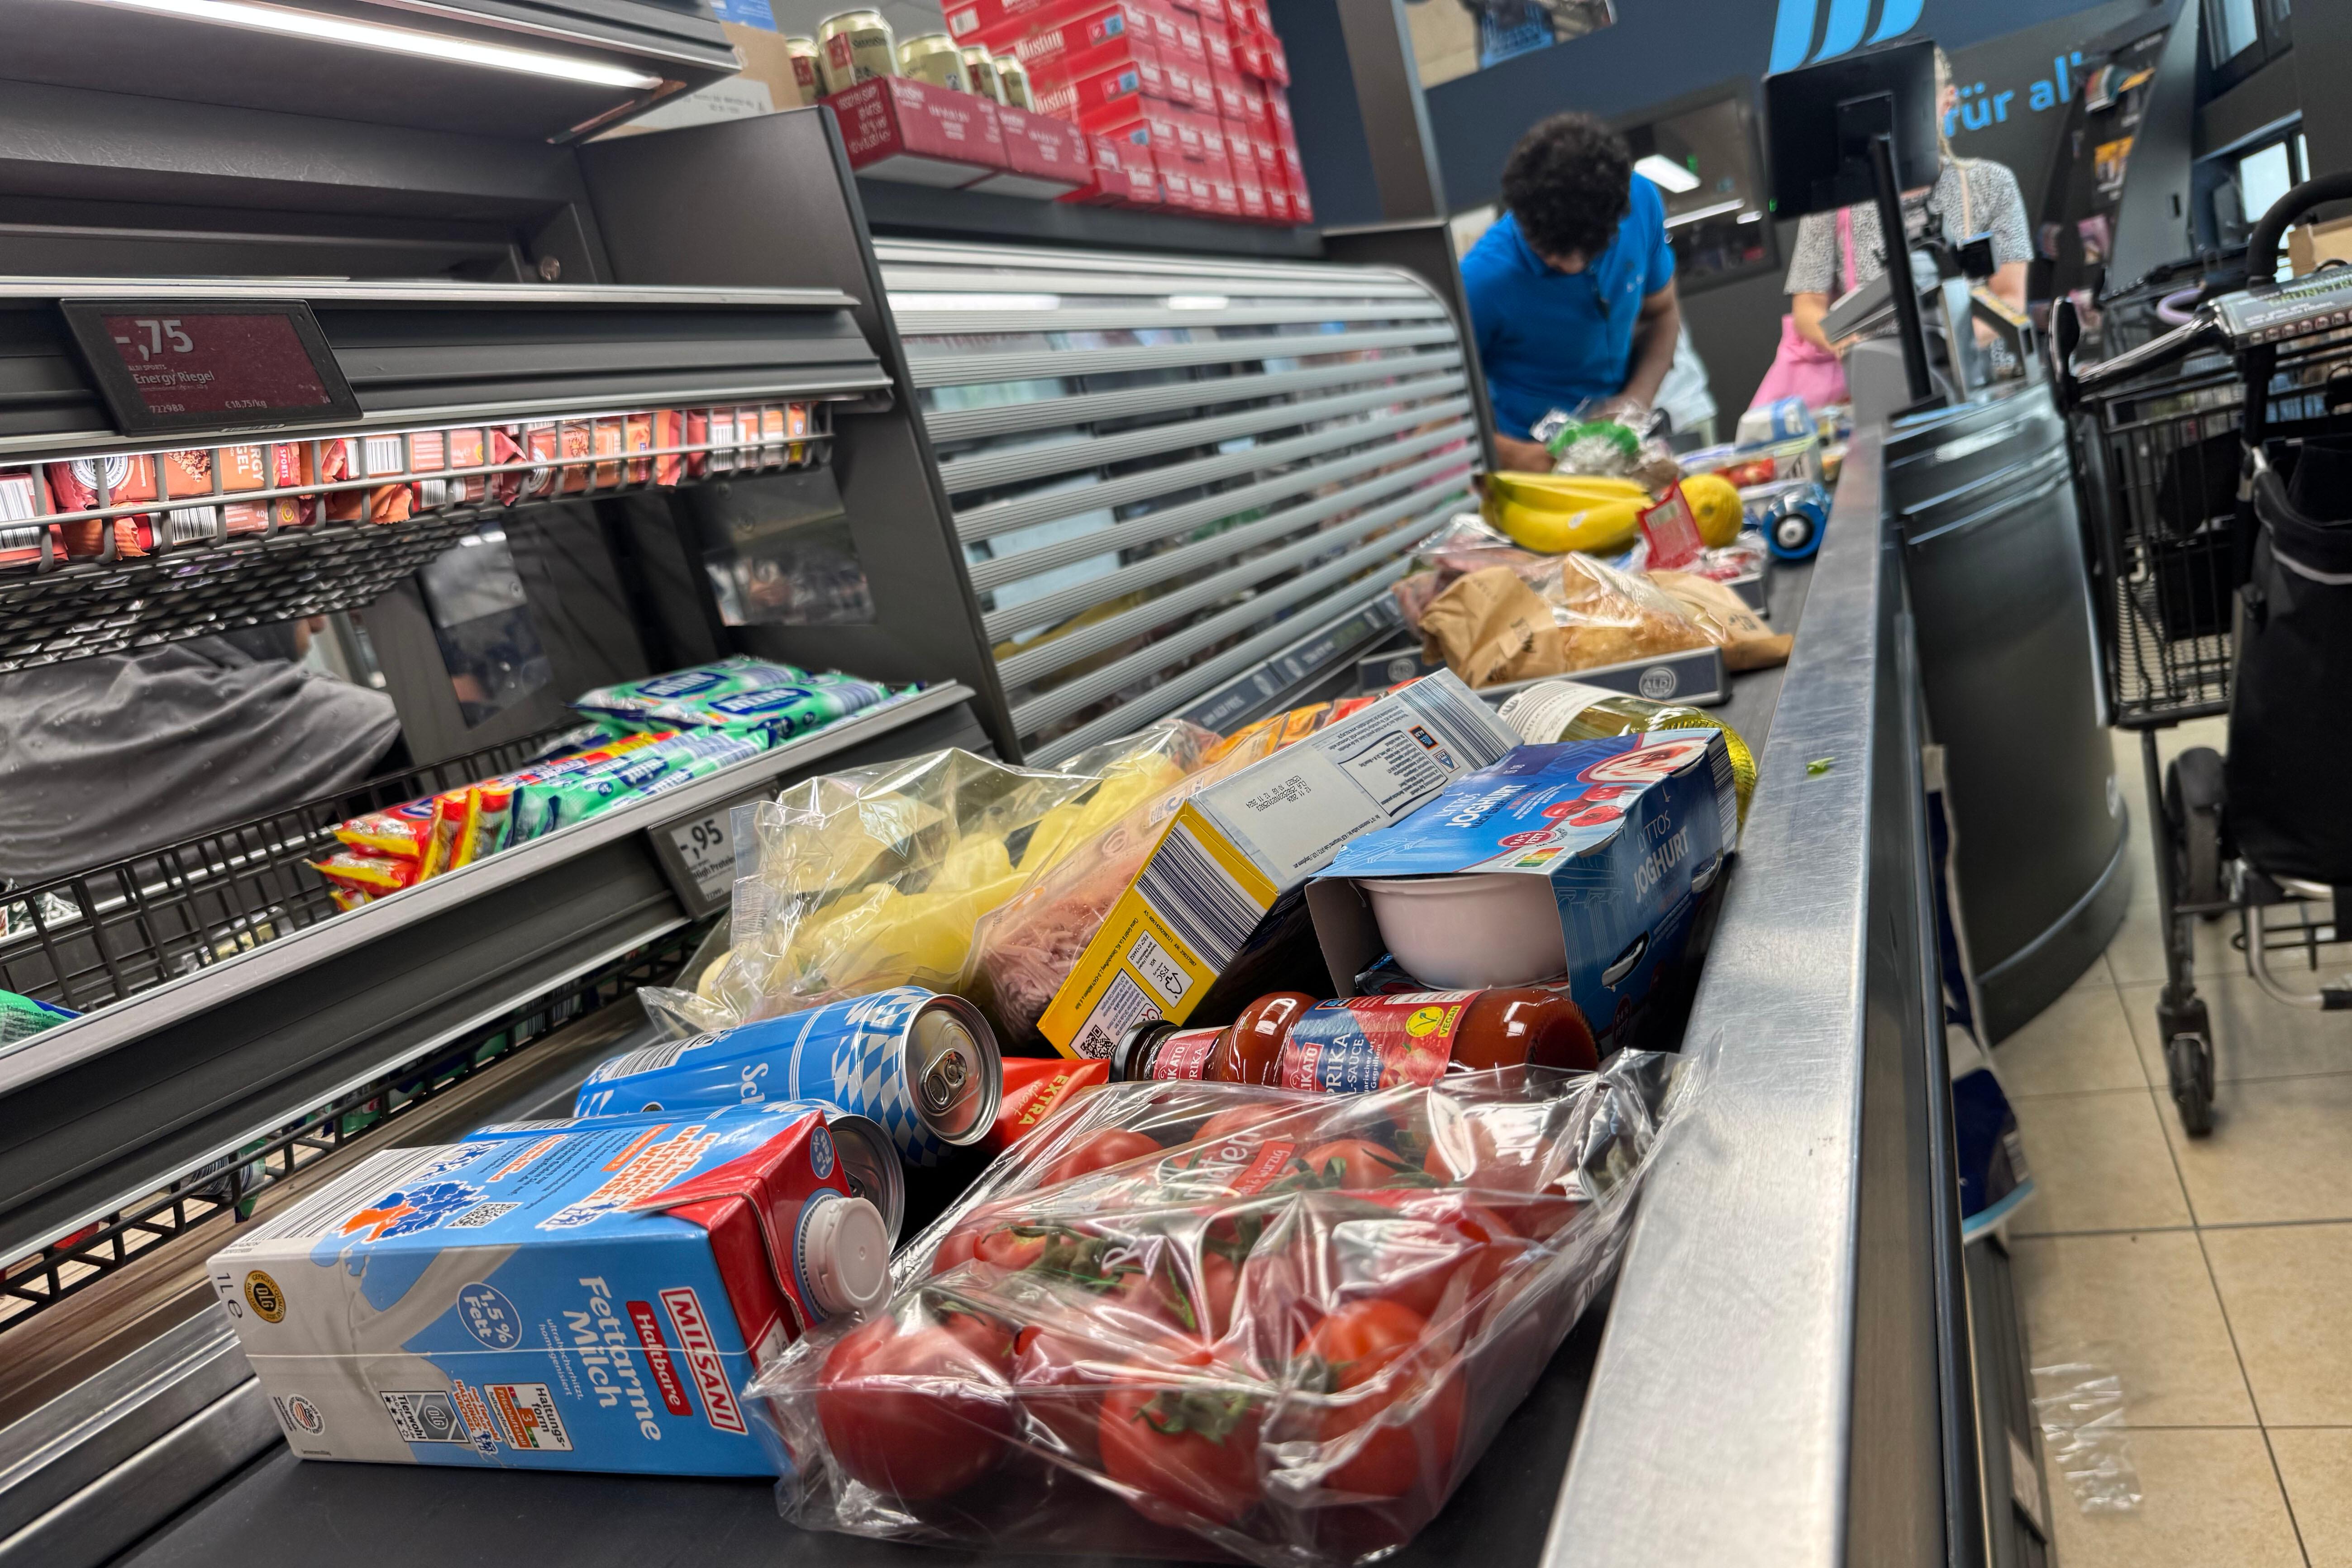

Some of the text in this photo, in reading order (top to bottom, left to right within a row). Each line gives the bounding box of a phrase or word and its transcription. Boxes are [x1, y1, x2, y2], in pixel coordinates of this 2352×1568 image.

[135, 371, 215, 385] Energy Riegel
[279, 449, 289, 478] SPORTS
[1433, 793, 1480, 817] LYTTOS
[1444, 784, 1527, 828] JOGHURT
[1636, 809, 1671, 852] LYTTOS
[693, 856, 736, 879] High Protein
[1634, 828, 1689, 900] JOGHURT
[1156, 965, 1169, 982] FSC
[1441, 1007, 1459, 1035] VEGAN
[1167, 1046, 1185, 1080] IKATO
[1188, 1046, 1205, 1079] RIKA
[1300, 1048, 1318, 1091] IKATO
[1370, 1043, 1384, 1089] Gegrilltem
[1011, 1080, 1043, 1116] scharf
[1018, 1075, 1069, 1125] EXTRA
[583, 1144, 668, 1202] WECHSEL
[611, 1127, 701, 1201] HALTUNGS-
[1259, 1149, 1290, 1177] würzig
[256, 1287, 275, 1307] DLG
[463, 1296, 493, 1337] Fett
[477, 1291, 514, 1342] 1,5 %
[538, 1324, 572, 1395] homogenisiert
[546, 1319, 584, 1400] ultrahocherhitzt,
[563, 1311, 622, 1407] Milch
[578, 1276, 663, 1440] Fettarme
[635, 1314, 684, 1405] Haltbare
[671, 1300, 735, 1420] MILSANI
[397, 1396, 426, 1439] Tierwohl
[427, 1410, 446, 1425] DLG
[454, 1393, 476, 1432] WECHSEL
[455, 1381, 482, 1430] HALTUNGS-
[478, 1403, 500, 1440] Tierwohl
[489, 1392, 515, 1443] haltungsform.de
[497, 1390, 526, 1444] Frischluftstall
[531, 1403, 549, 1431] form
[535, 1388, 566, 1447] Haltungs-
